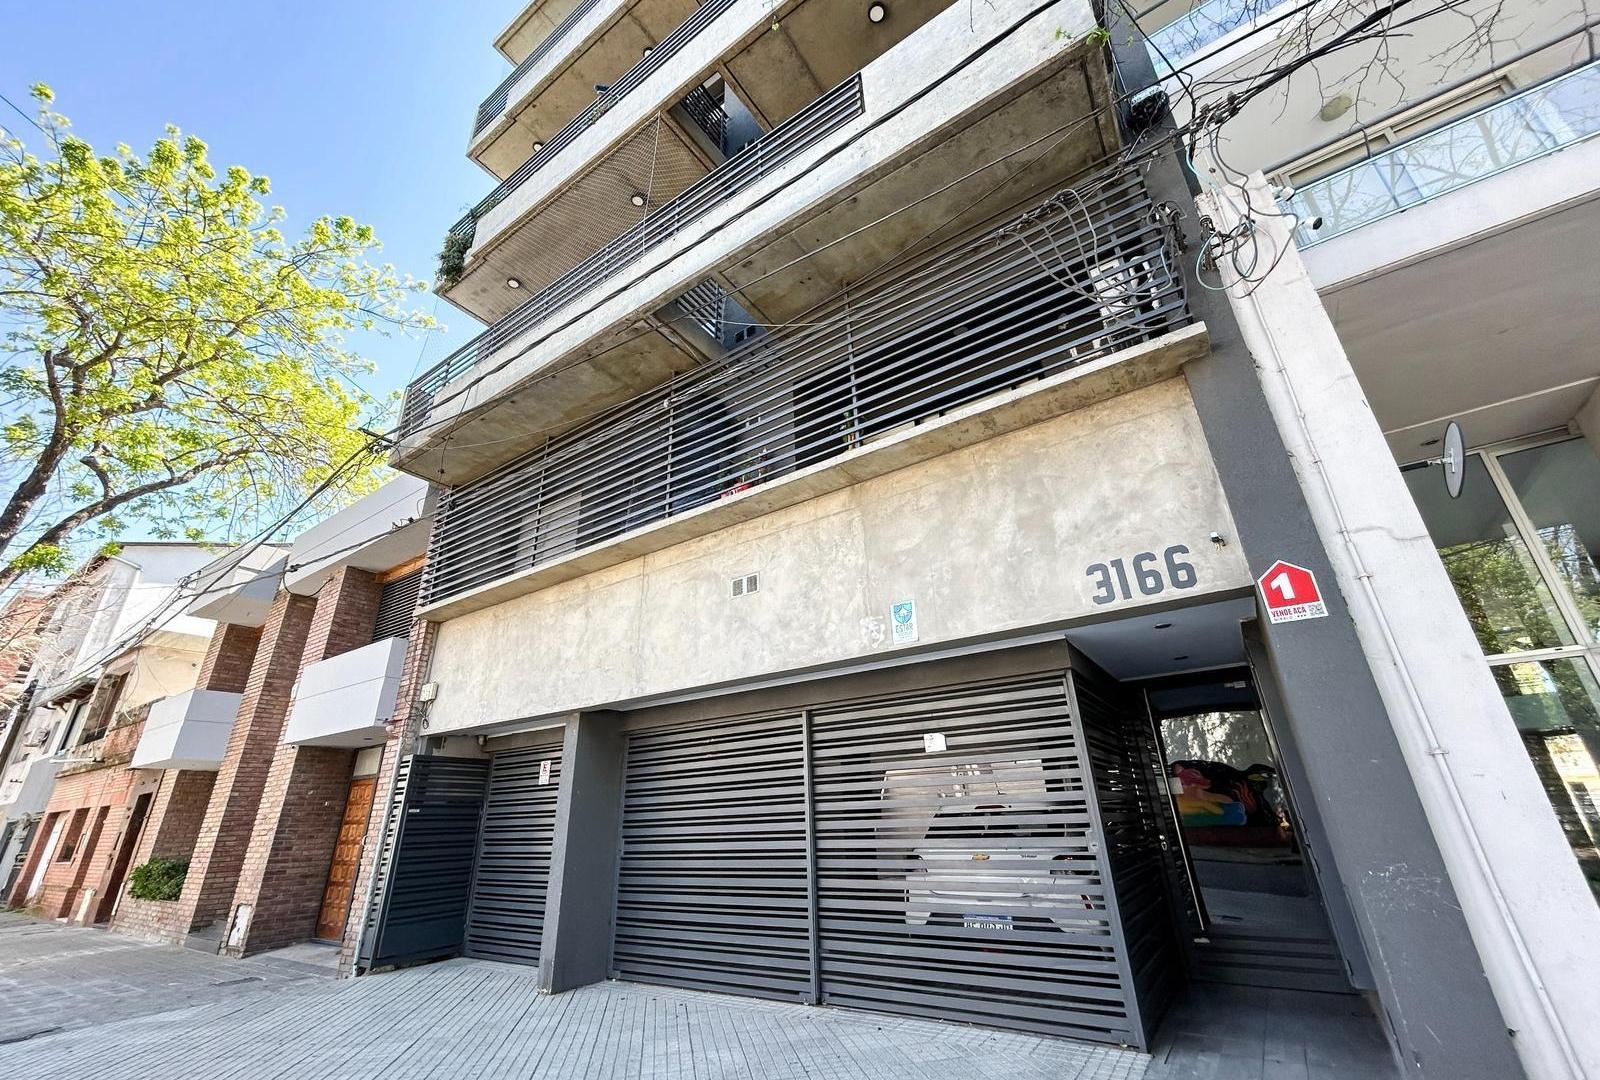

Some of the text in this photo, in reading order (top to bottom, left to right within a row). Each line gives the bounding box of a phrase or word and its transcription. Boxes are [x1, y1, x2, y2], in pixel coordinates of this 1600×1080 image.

[1085, 544, 1197, 605] 3166
[1270, 572, 1296, 600] 1
[1271, 608, 1292, 617] VENDE
[895, 622, 914, 633] ESTAR
